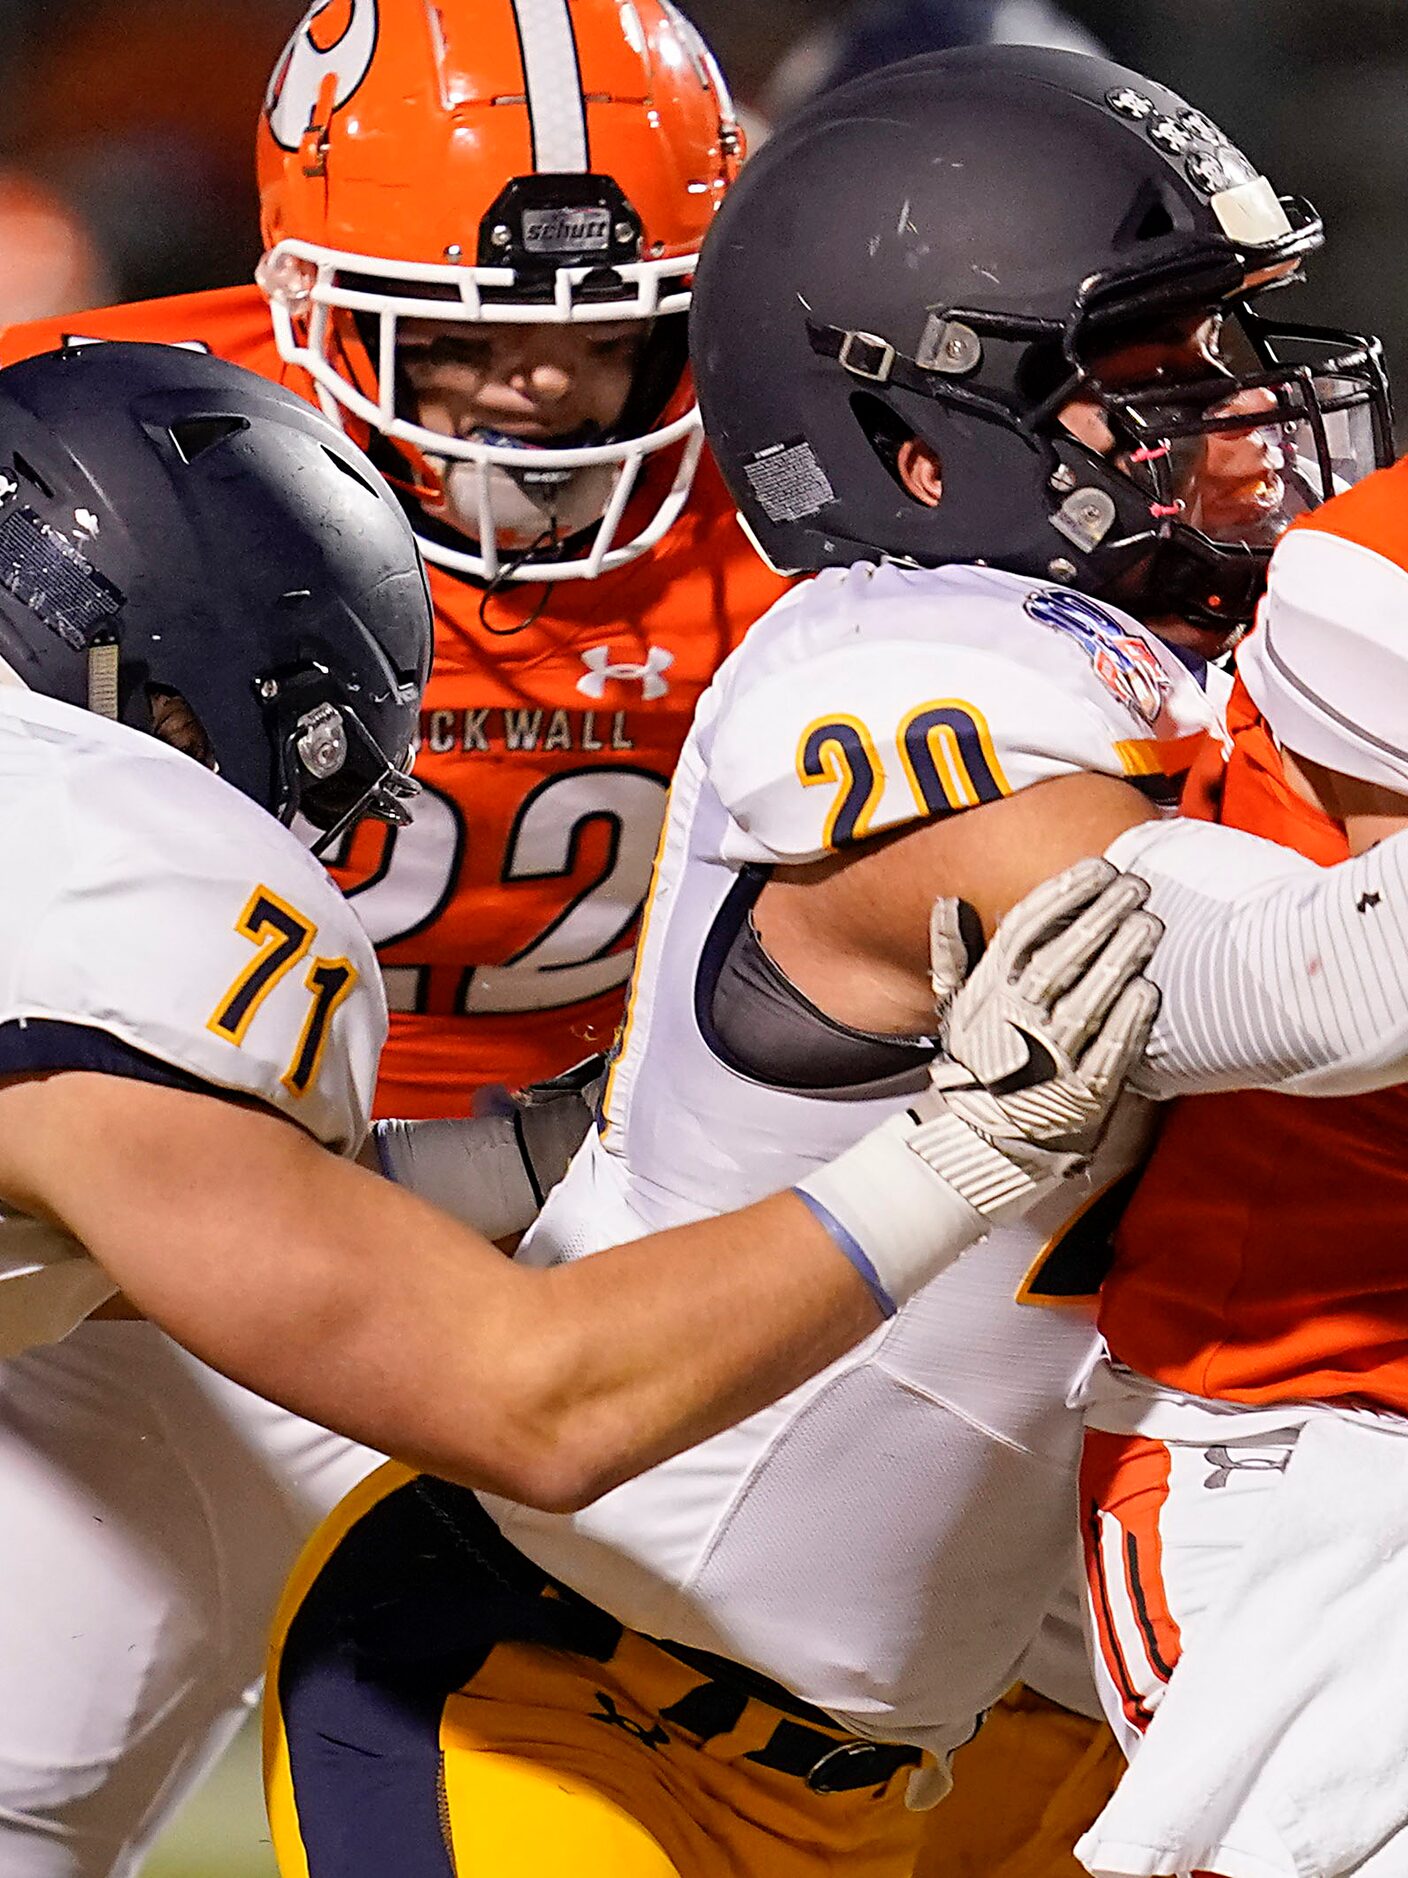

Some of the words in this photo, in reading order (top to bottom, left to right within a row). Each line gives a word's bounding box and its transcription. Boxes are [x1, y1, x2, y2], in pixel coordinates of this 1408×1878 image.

[526, 220, 607, 241] schutt
[796, 697, 1014, 852] 20
[206, 883, 360, 1098] 71
